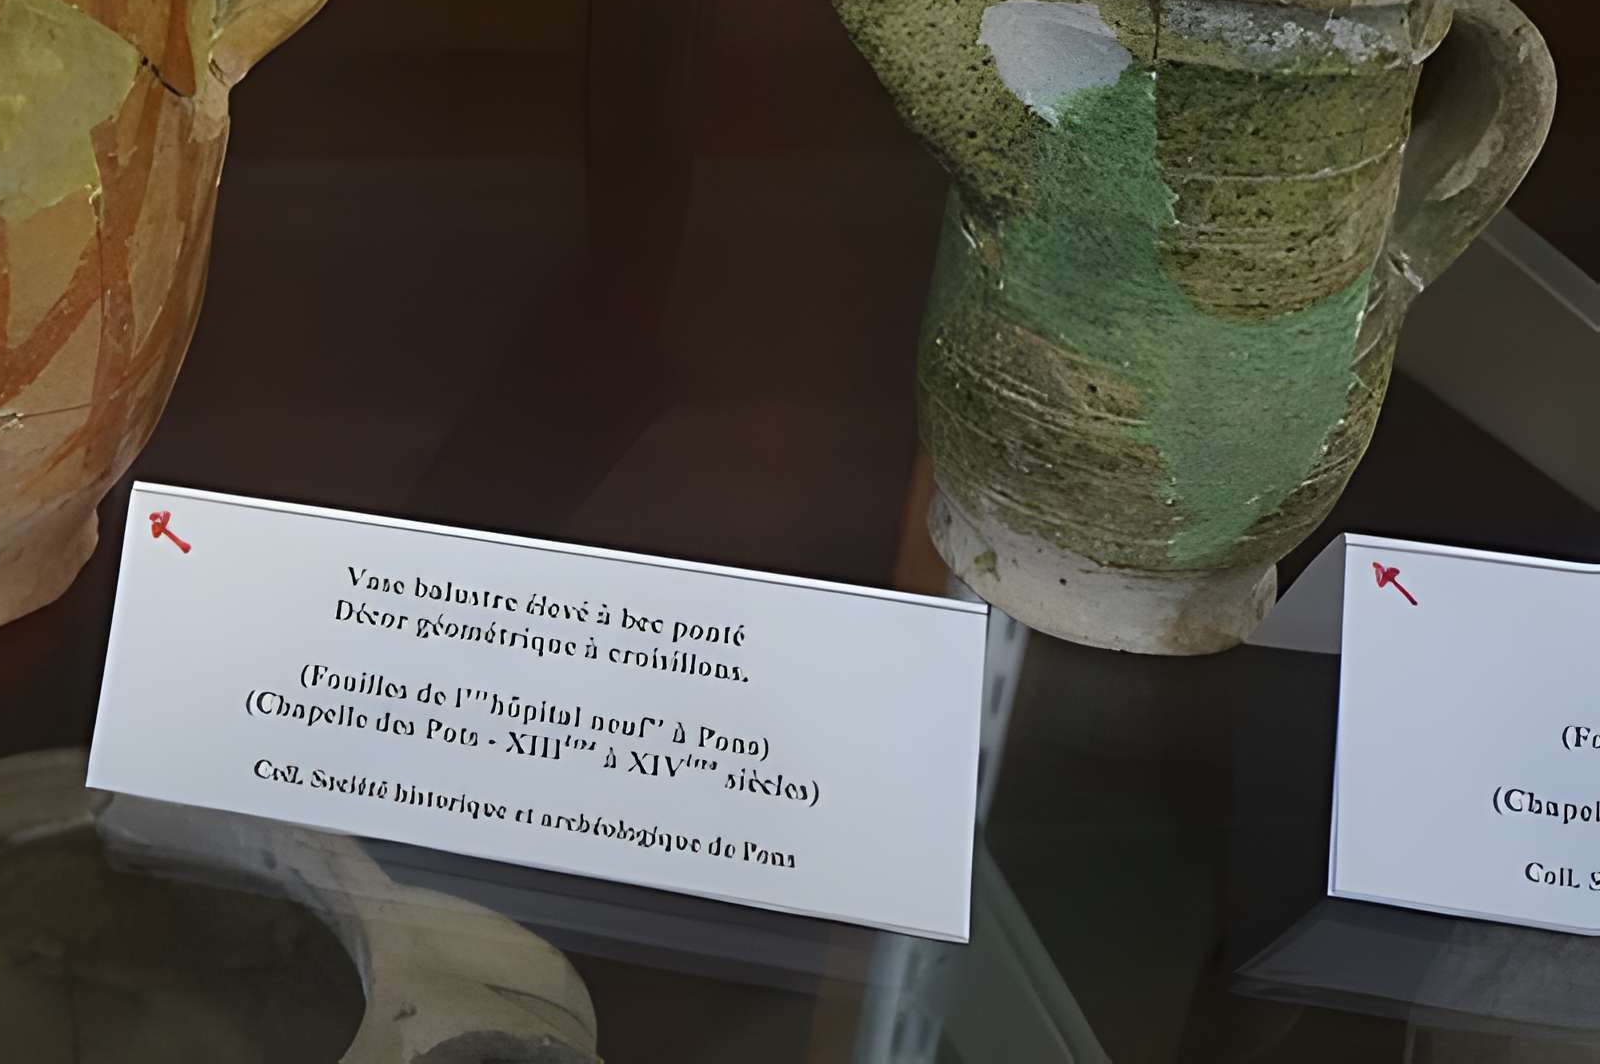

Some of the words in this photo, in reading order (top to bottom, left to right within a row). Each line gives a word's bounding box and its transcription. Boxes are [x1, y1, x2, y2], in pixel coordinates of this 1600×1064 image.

[335, 599, 409, 630] Décor
[416, 613, 577, 658] géométrique
[584, 636, 598, 660] à
[608, 647, 749, 683] croisillons.
[347, 566, 405, 595] Vase
[414, 576, 518, 612] balustre
[526, 593, 589, 623] élevé
[596, 603, 611, 626] à
[621, 607, 664, 634] bec
[671, 621, 745, 647] ponté
[245, 689, 368, 729] (Chapelle
[375, 711, 415, 736] des
[426, 718, 479, 747] Pots
[602, 746, 617, 769] à
[724, 767, 820, 808] siècles)
[300, 664, 408, 700] (Fouilles
[416, 682, 447, 707] de
[672, 721, 686, 744] à
[697, 726, 769, 762] Pons)
[310, 768, 388, 800] Société
[393, 783, 507, 820] historique
[514, 808, 534, 825] et
[540, 812, 702, 854] archéologique
[708, 836, 736, 859] de
[743, 841, 796, 869] Pons
